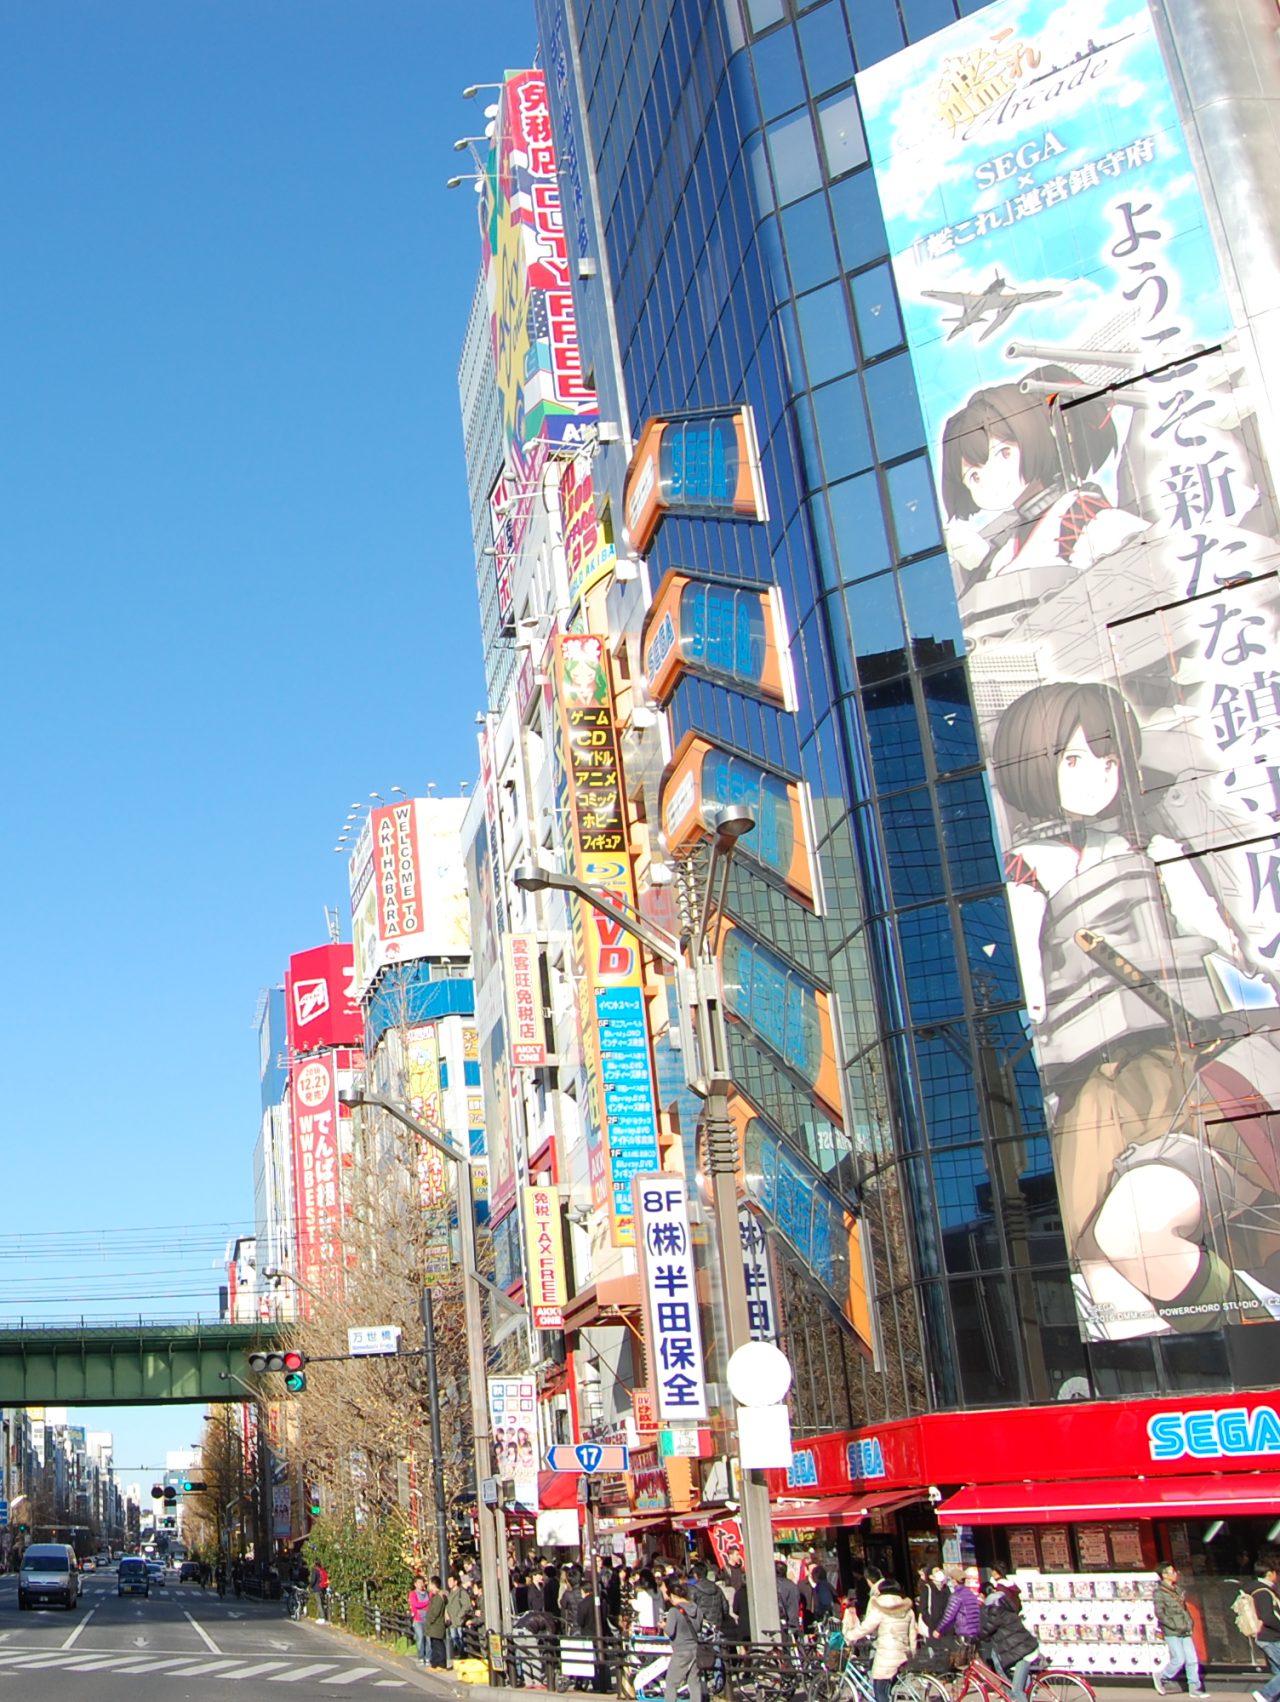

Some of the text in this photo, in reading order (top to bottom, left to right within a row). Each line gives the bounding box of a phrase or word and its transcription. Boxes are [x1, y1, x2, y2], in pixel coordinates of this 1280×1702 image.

[962, 57, 1109, 142] Arcade
[974, 132, 1068, 190] SEGA
[913, 137, 1156, 264] 「艦これ」運営鎮守府
[673, 427, 728, 497] SEGA
[693, 593, 752, 675] SEGA
[648, 613, 674, 684] SEGA
[571, 710, 609, 726] ゲーム
[576, 730, 607, 747] CD
[574, 750, 614, 767] アイドル
[575, 771, 617, 787] アニメ
[578, 791, 617, 807] コミック
[582, 812, 618, 829] ホビー
[581, 834, 621, 850] フィギュア
[381, 820, 398, 935] AKIHABARA
[396, 808, 416, 930] WELCOME TO
[512, 939, 536, 1039] 愛客旺免税店
[515, 1045, 542, 1054] AKKY
[517, 1053, 541, 1063] ONE
[299, 1076, 328, 1092] 12.21
[534, 1193, 551, 1217] 免税
[643, 1190, 682, 1212] 8F
[537, 1222, 557, 1303] TAX FREE
[539, 1317, 562, 1326] ONE
[646, 1222, 701, 1406] (株)半田保全
[1159, 1304, 1220, 1317] POWERCHORD
[352, 1331, 393, 1343] 万世橋
[1147, 1406, 1280, 1461] SEGA
[581, 1450, 598, 1466] 17
[847, 1437, 886, 1480] SEGA
